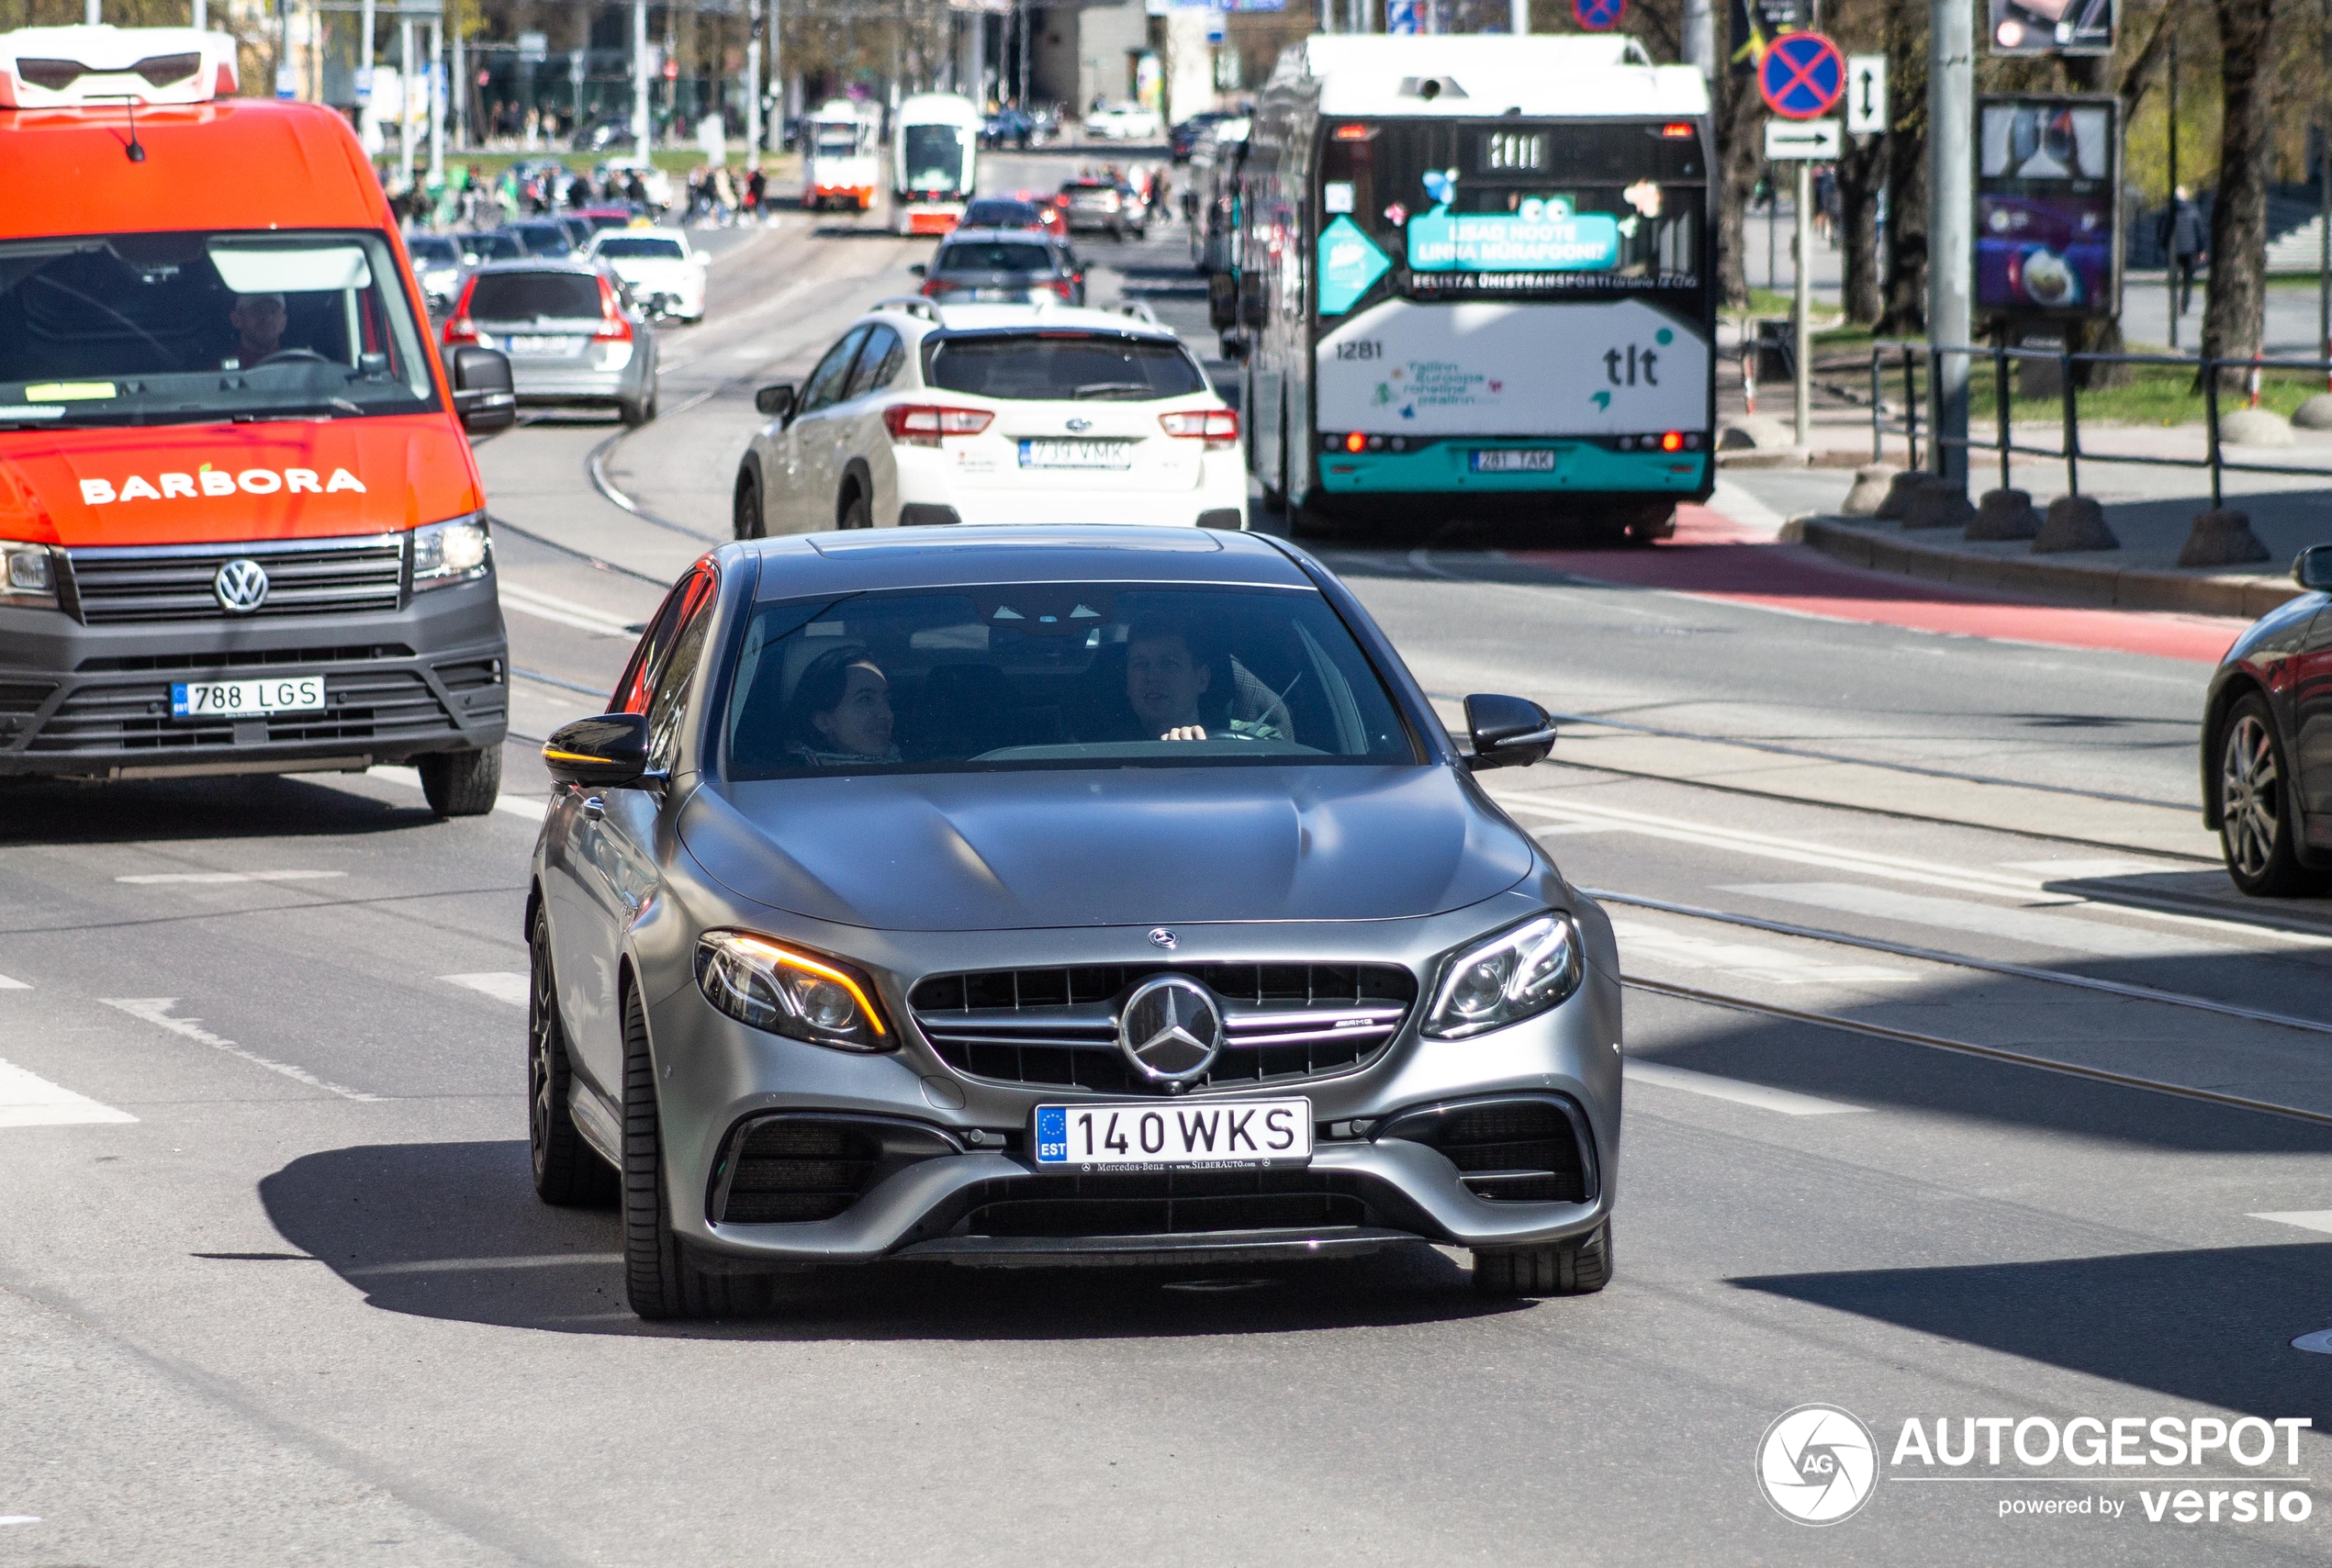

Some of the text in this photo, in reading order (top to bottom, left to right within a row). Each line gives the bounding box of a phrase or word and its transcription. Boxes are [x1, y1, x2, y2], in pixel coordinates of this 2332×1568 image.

[1449, 223, 1576, 241] LISAD NOOTE
[1412, 274, 1474, 288] EELISTA
[1337, 341, 1382, 360] 1281
[1602, 343, 1657, 386] tlt
[79, 467, 367, 506] BARBORA
[195, 682, 317, 711] 788 LGS
[1041, 1143, 1065, 1156] EST
[1097, 1162, 1164, 1171] Mercedes-Benz
